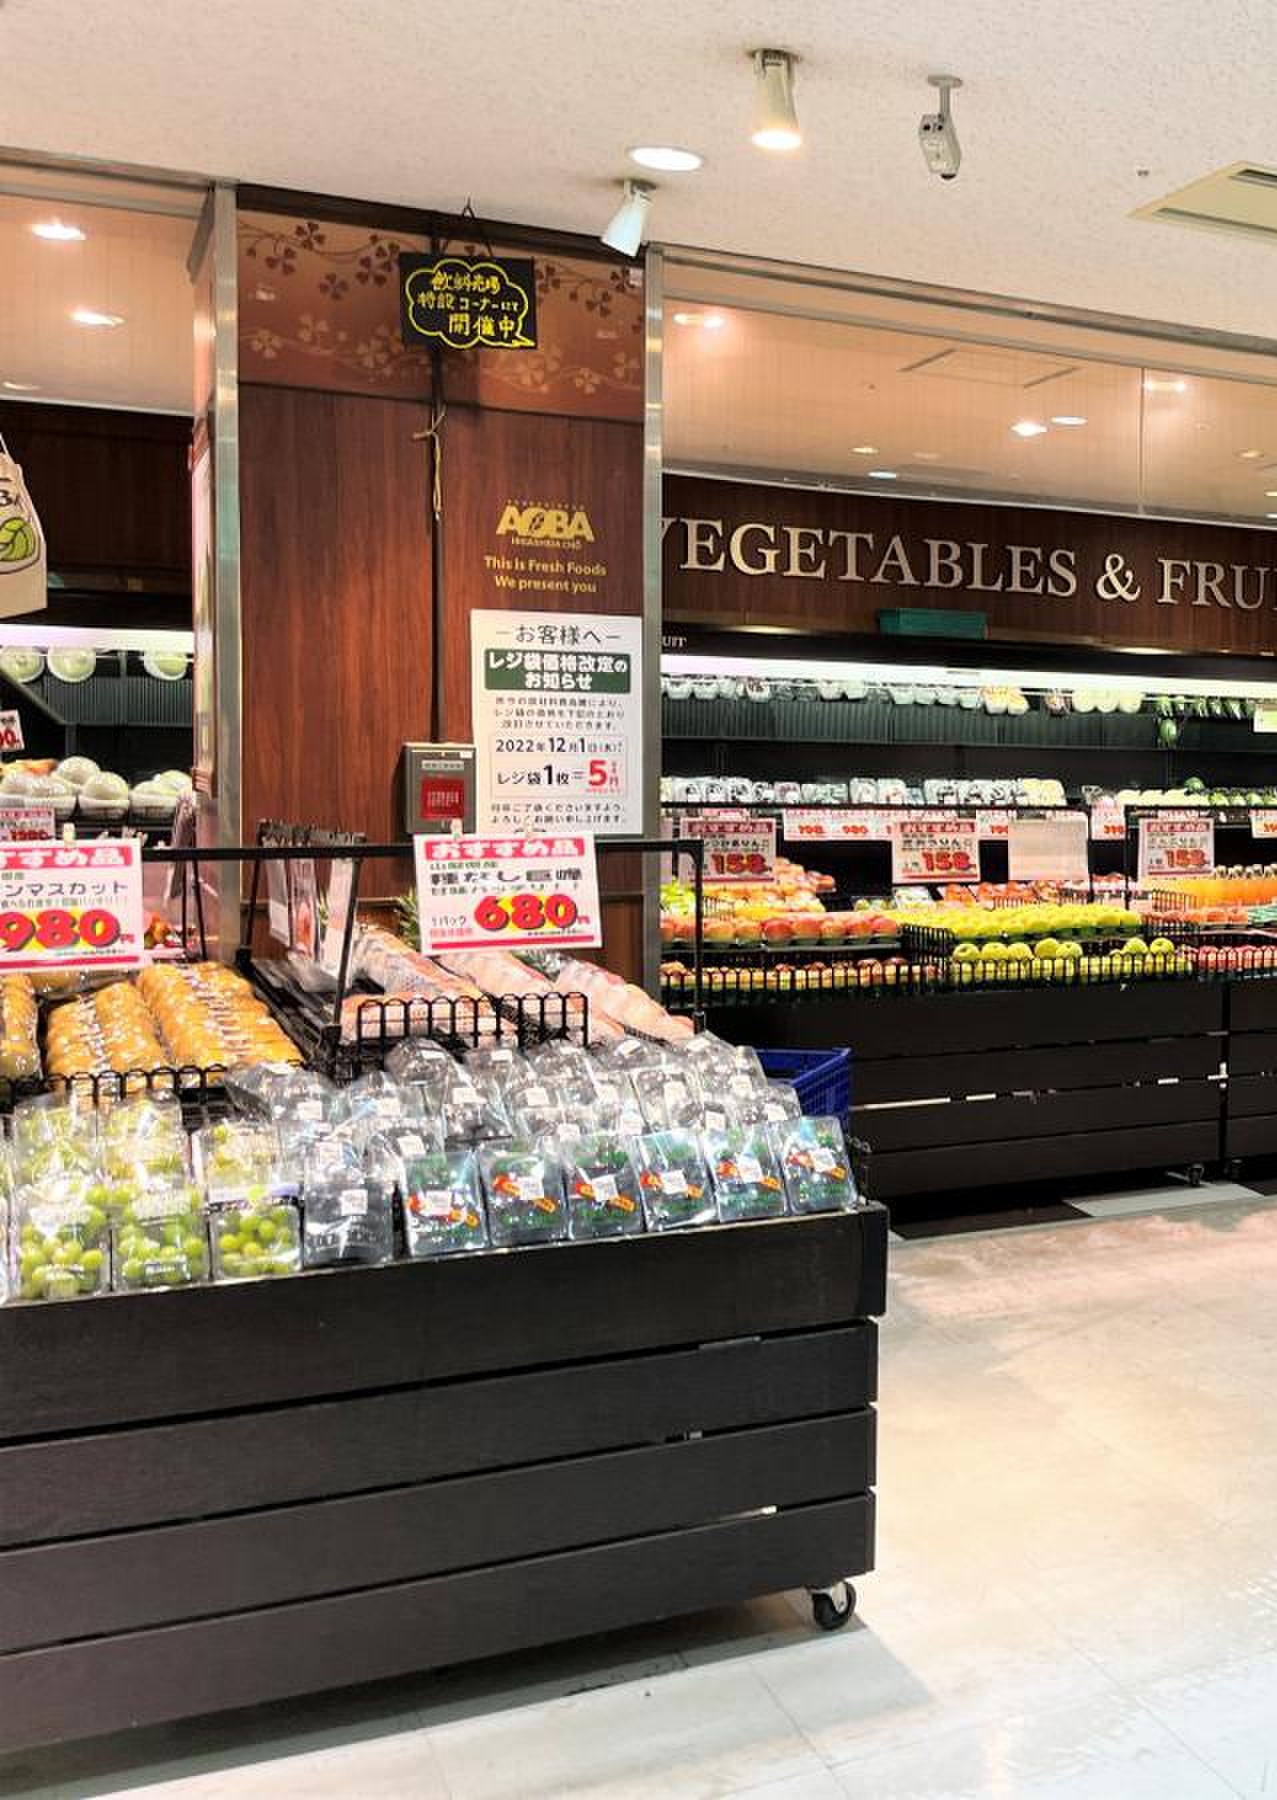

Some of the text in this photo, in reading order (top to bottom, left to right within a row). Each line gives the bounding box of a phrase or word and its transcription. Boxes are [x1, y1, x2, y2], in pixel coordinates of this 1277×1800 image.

[449, 313, 515, 339] 開催中
[484, 556, 608, 577] This is Fresh Foods
[1095, 552, 1140, 601] &
[495, 575, 597, 595] We present you
[525, 673, 593, 690] お知らせ
[431, 842, 579, 860] おすすめ品
